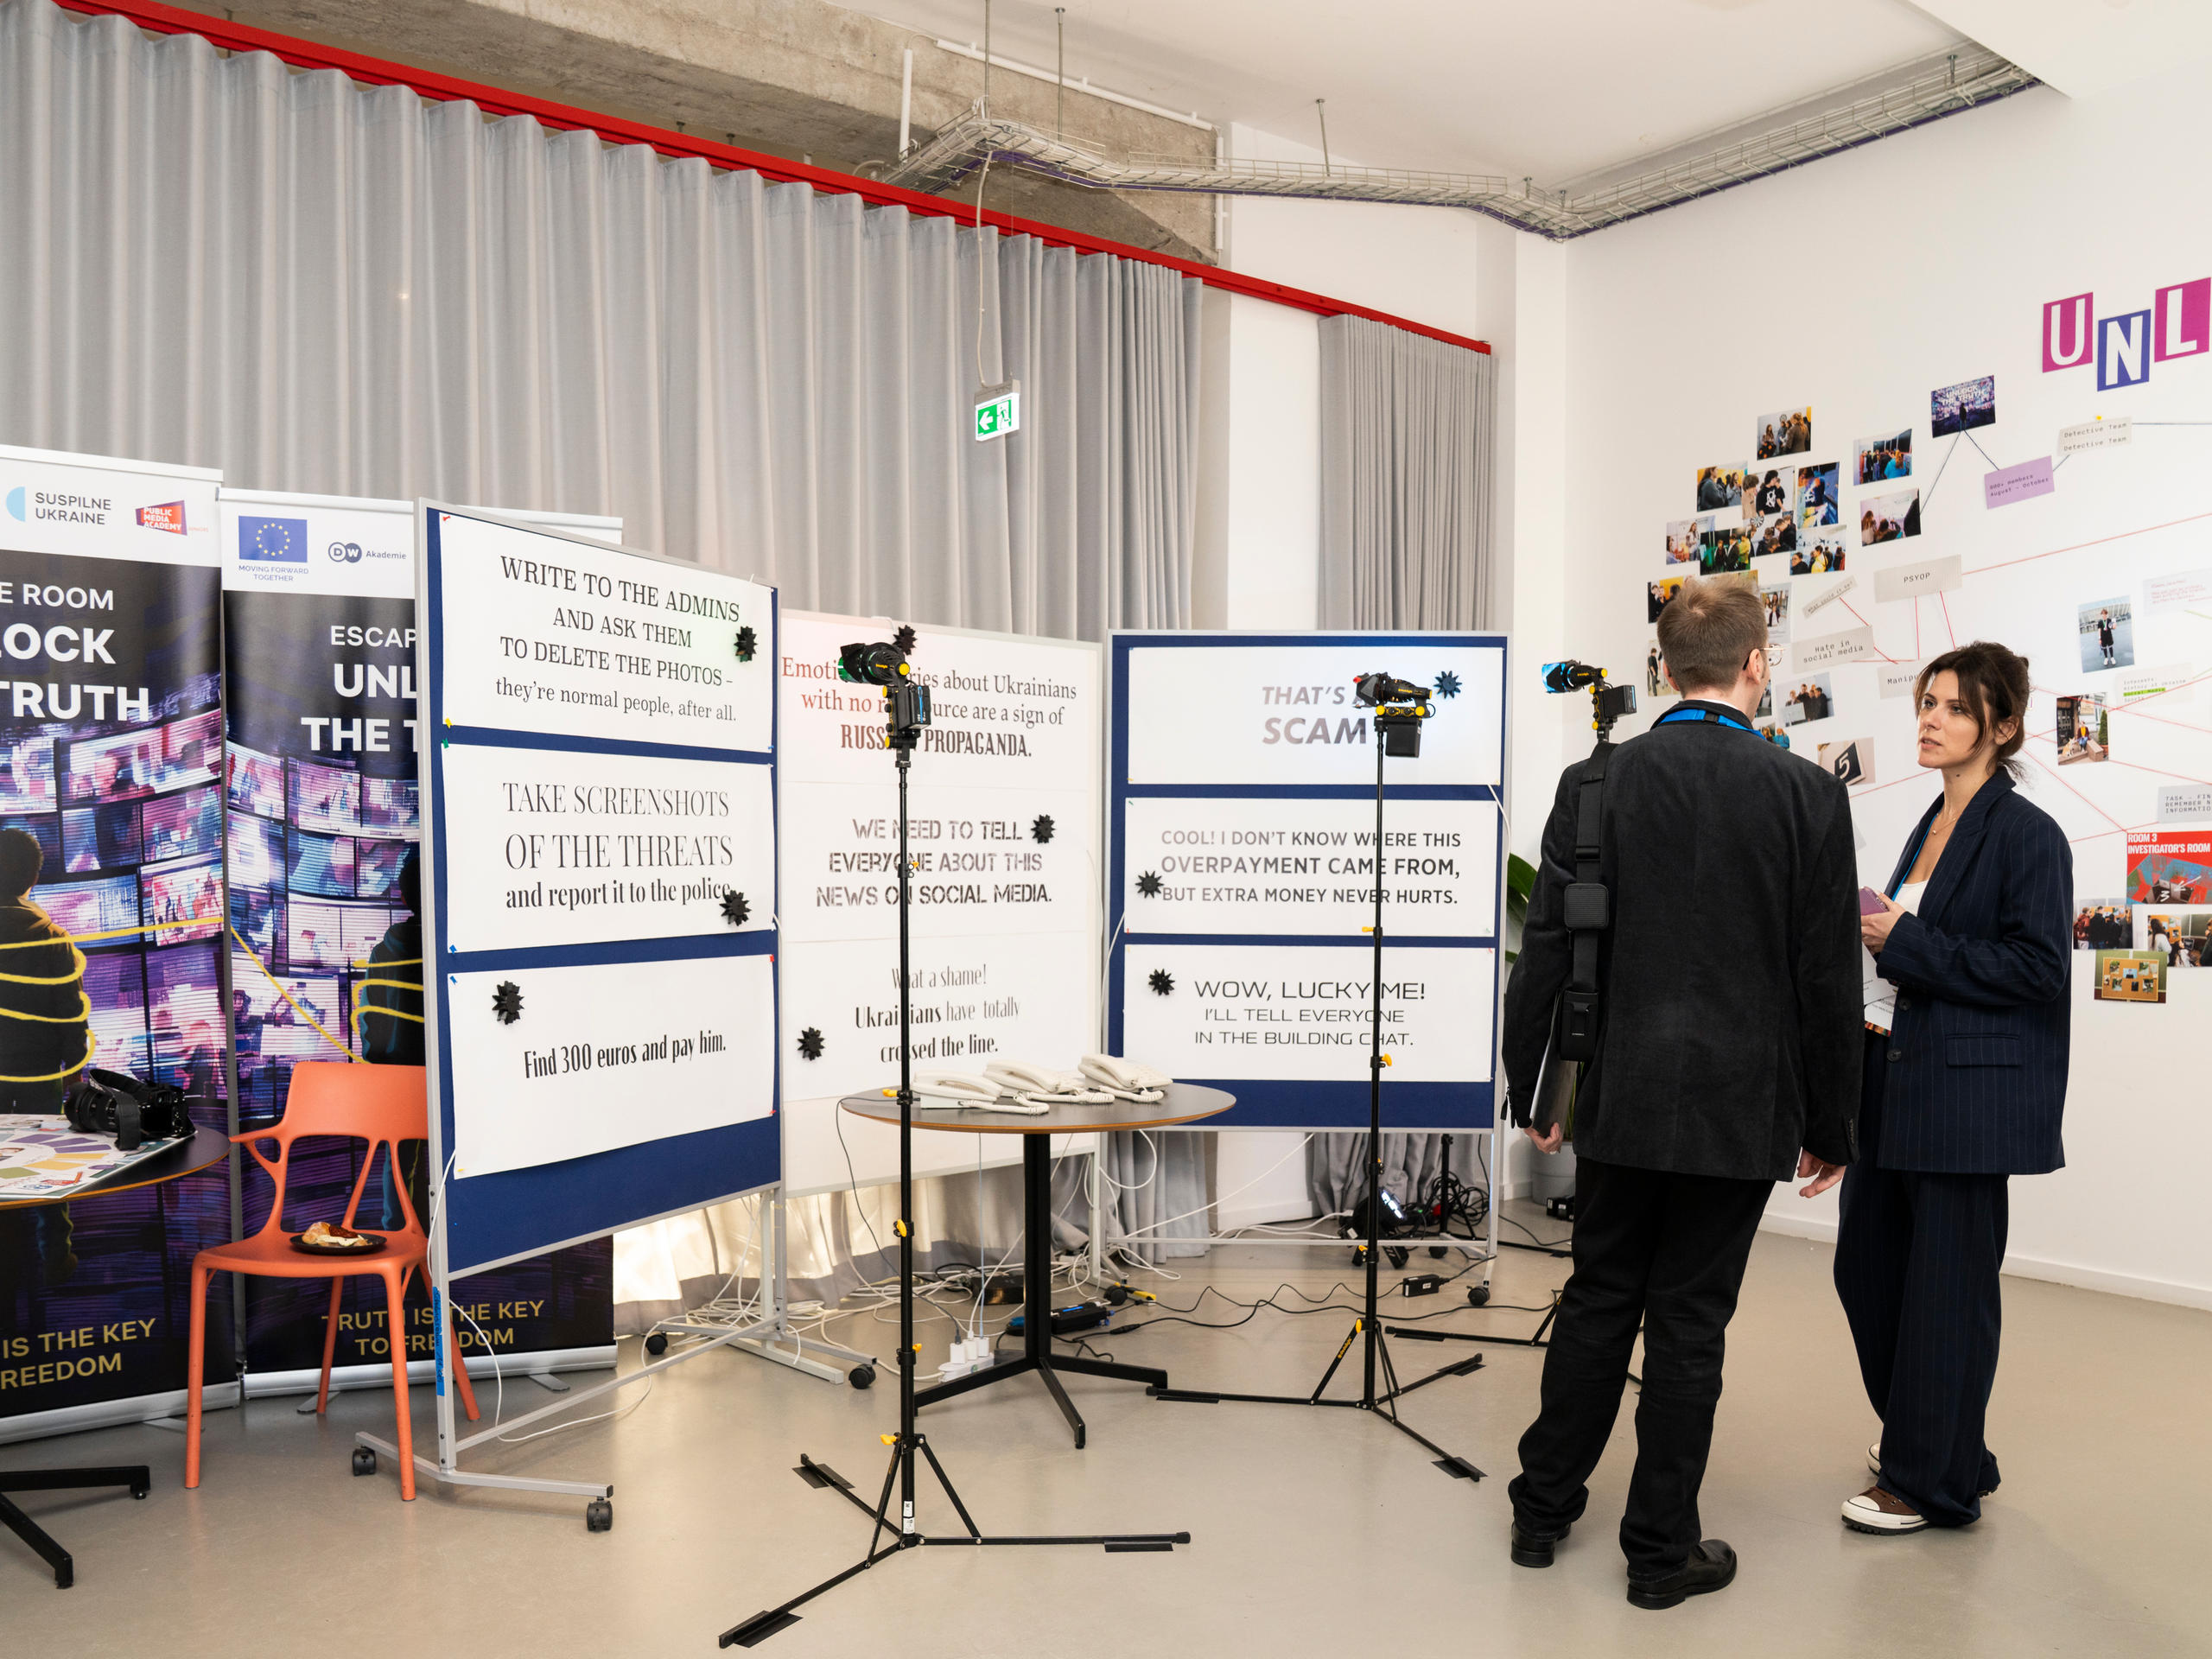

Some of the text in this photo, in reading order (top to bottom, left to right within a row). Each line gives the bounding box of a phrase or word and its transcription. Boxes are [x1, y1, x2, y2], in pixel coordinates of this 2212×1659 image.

[2050, 288, 2197, 386] UNL
[2063, 422, 2127, 439] Detective Team
[2063, 435, 2127, 452] Detective Team
[35, 492, 111, 511] SUSPILNE
[143, 506, 173, 517] PUBLIC
[35, 508, 105, 525] UKRAINE
[143, 513, 170, 524] MEDIA
[143, 520, 182, 531] ACADEMY
[365, 550, 407, 560] Akademie
[238, 564, 309, 575] MOVING FORWARD
[253, 574, 295, 582] TOGETHER
[1904, 572, 1931, 583] PSYOP
[22, 582, 114, 611] ROOM
[500, 556, 741, 622] WRITE TO THE ADMINS
[553, 607, 692, 648] AND ASK THEM
[0, 622, 117, 664] OCK
[1815, 643, 1835, 653] Hate
[500, 636, 528, 658] TO
[534, 641, 610, 671] DELETE
[615, 654, 652, 677] THE
[657, 660, 722, 686] PHOTOS
[1803, 645, 1864, 664] social media
[943, 670, 989, 692] about
[994, 674, 1077, 699] Ukrainians
[496, 677, 737, 721] they're normal people, after all.
[1262, 686, 1345, 706] THAT'S
[802, 689, 845, 710] with
[849, 696, 872, 713] no
[972, 704, 996, 721] are
[1001, 708, 1009, 721] a
[1013, 704, 1045, 728] sign
[1048, 706, 1066, 726] of
[300, 716, 391, 753] THE
[1262, 717, 1367, 745] SCAM
[925, 728, 1033, 758] PROPAGANDA.
[1839, 752, 1850, 779] 5
[503, 782, 730, 817] TAKE SCREENSHOTS
[853, 818, 886, 839] WE
[949, 820, 974, 840] TO
[981, 821, 1023, 841] TELL
[1160, 830, 1215, 845] COOL!
[1221, 830, 1225, 845] I
[1231, 830, 1286, 846] DON'T
[1292, 831, 1348, 846] KNOW
[1423, 833, 1461, 848] THIS
[2127, 833, 2158, 842] ROOM 3
[505, 834, 734, 870] OF THE THREATS
[2127, 843, 2211, 855] INVESTIGATOR'S ROOM
[938, 852, 997, 872] ABOUT
[1004, 852, 1042, 872] THIS
[1160, 855, 1321, 874] OVERPAYMENT
[1394, 858, 1460, 880] FROM,
[505, 881, 543, 909] and
[549, 882, 609, 912] report
[613, 880, 626, 905] it
[629, 882, 646, 905] to
[651, 878, 677, 902] the
[816, 887, 879, 907] NEWS
[918, 885, 988, 905] SOCIAL
[993, 884, 1052, 905] MEDIA.
[1162, 887, 1458, 905] BUT EXTRA MONEY NEVER HURTS.
[892, 964, 987, 989] Wat a shame!
[1194, 981, 1425, 1001] WOW, LUCKY ME!
[855, 996, 1021, 1028] Ukraiians have totally
[1205, 1008, 1405, 1023] I'LL TELL EVERYONE
[880, 1034, 999, 1064] crosed the line.
[1195, 1032, 1212, 1045] IN
[1219, 1032, 1257, 1045] THE
[1265, 1032, 1353, 1046] BUILDING
[524, 1030, 727, 1079] Find 300 euros and pay him.
[498, 1300, 545, 1319] KEY
[3, 1318, 156, 1359] IS THE KEY
[354, 1337, 389, 1356] TO
